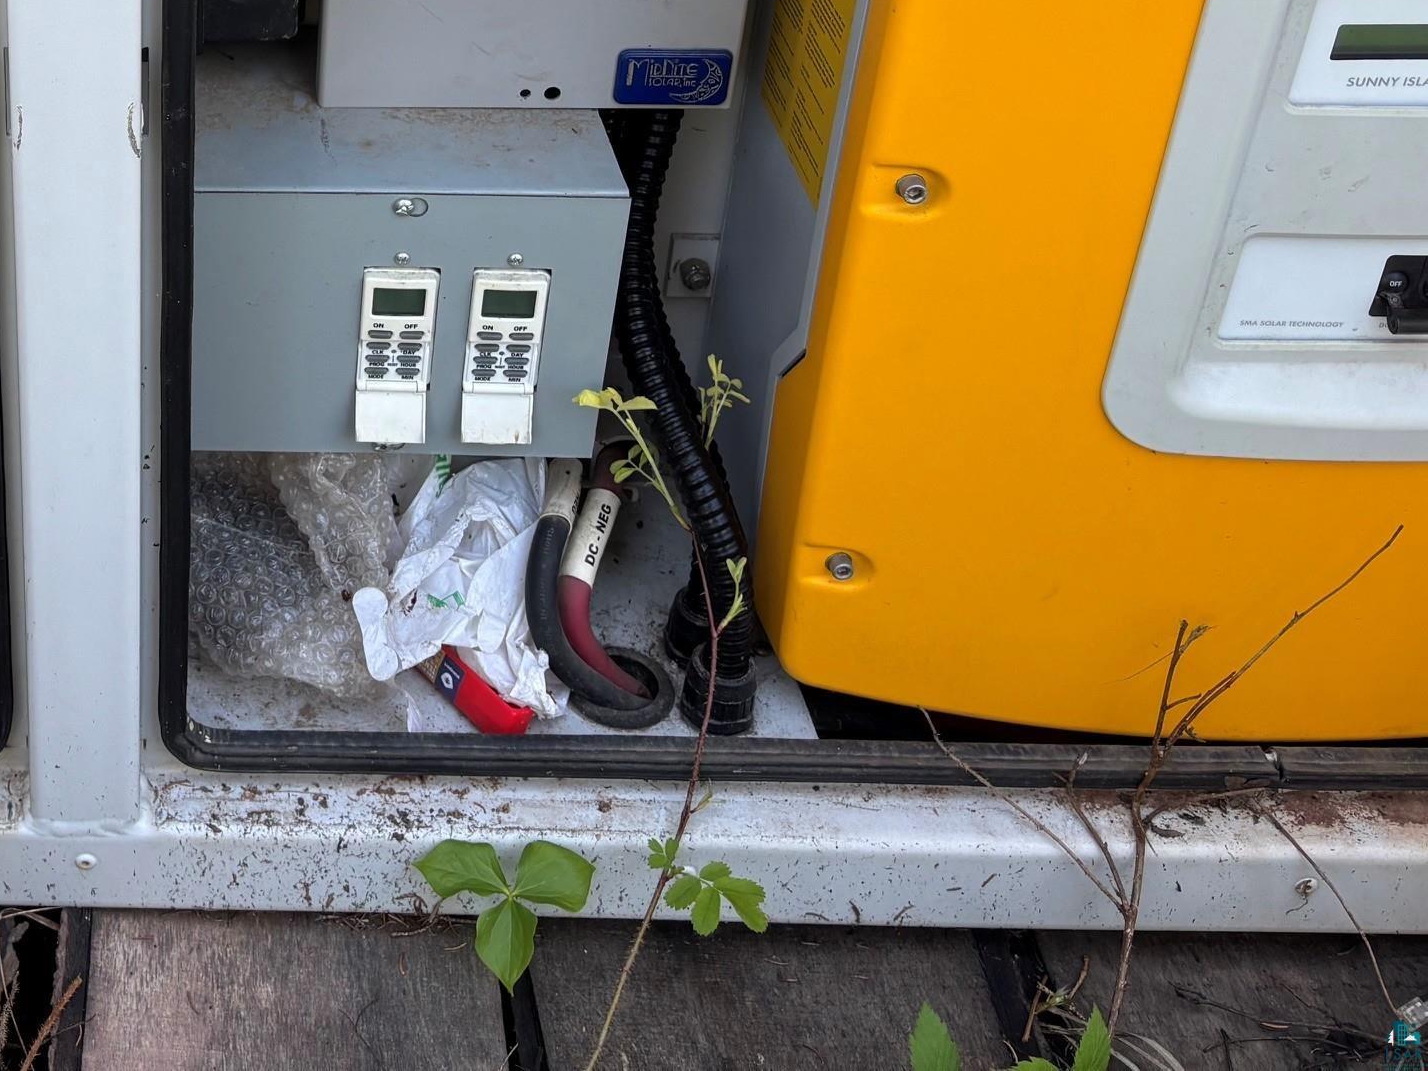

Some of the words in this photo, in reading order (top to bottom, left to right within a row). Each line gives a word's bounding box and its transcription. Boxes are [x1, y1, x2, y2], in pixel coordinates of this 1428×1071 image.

[1346, 77, 1400, 87] SUNNY
[1260, 320, 1287, 328] SOLAR
[1288, 320, 1345, 328] TECHNOLOGY
[584, 543, 599, 567] DC
[595, 503, 612, 534] NEG
